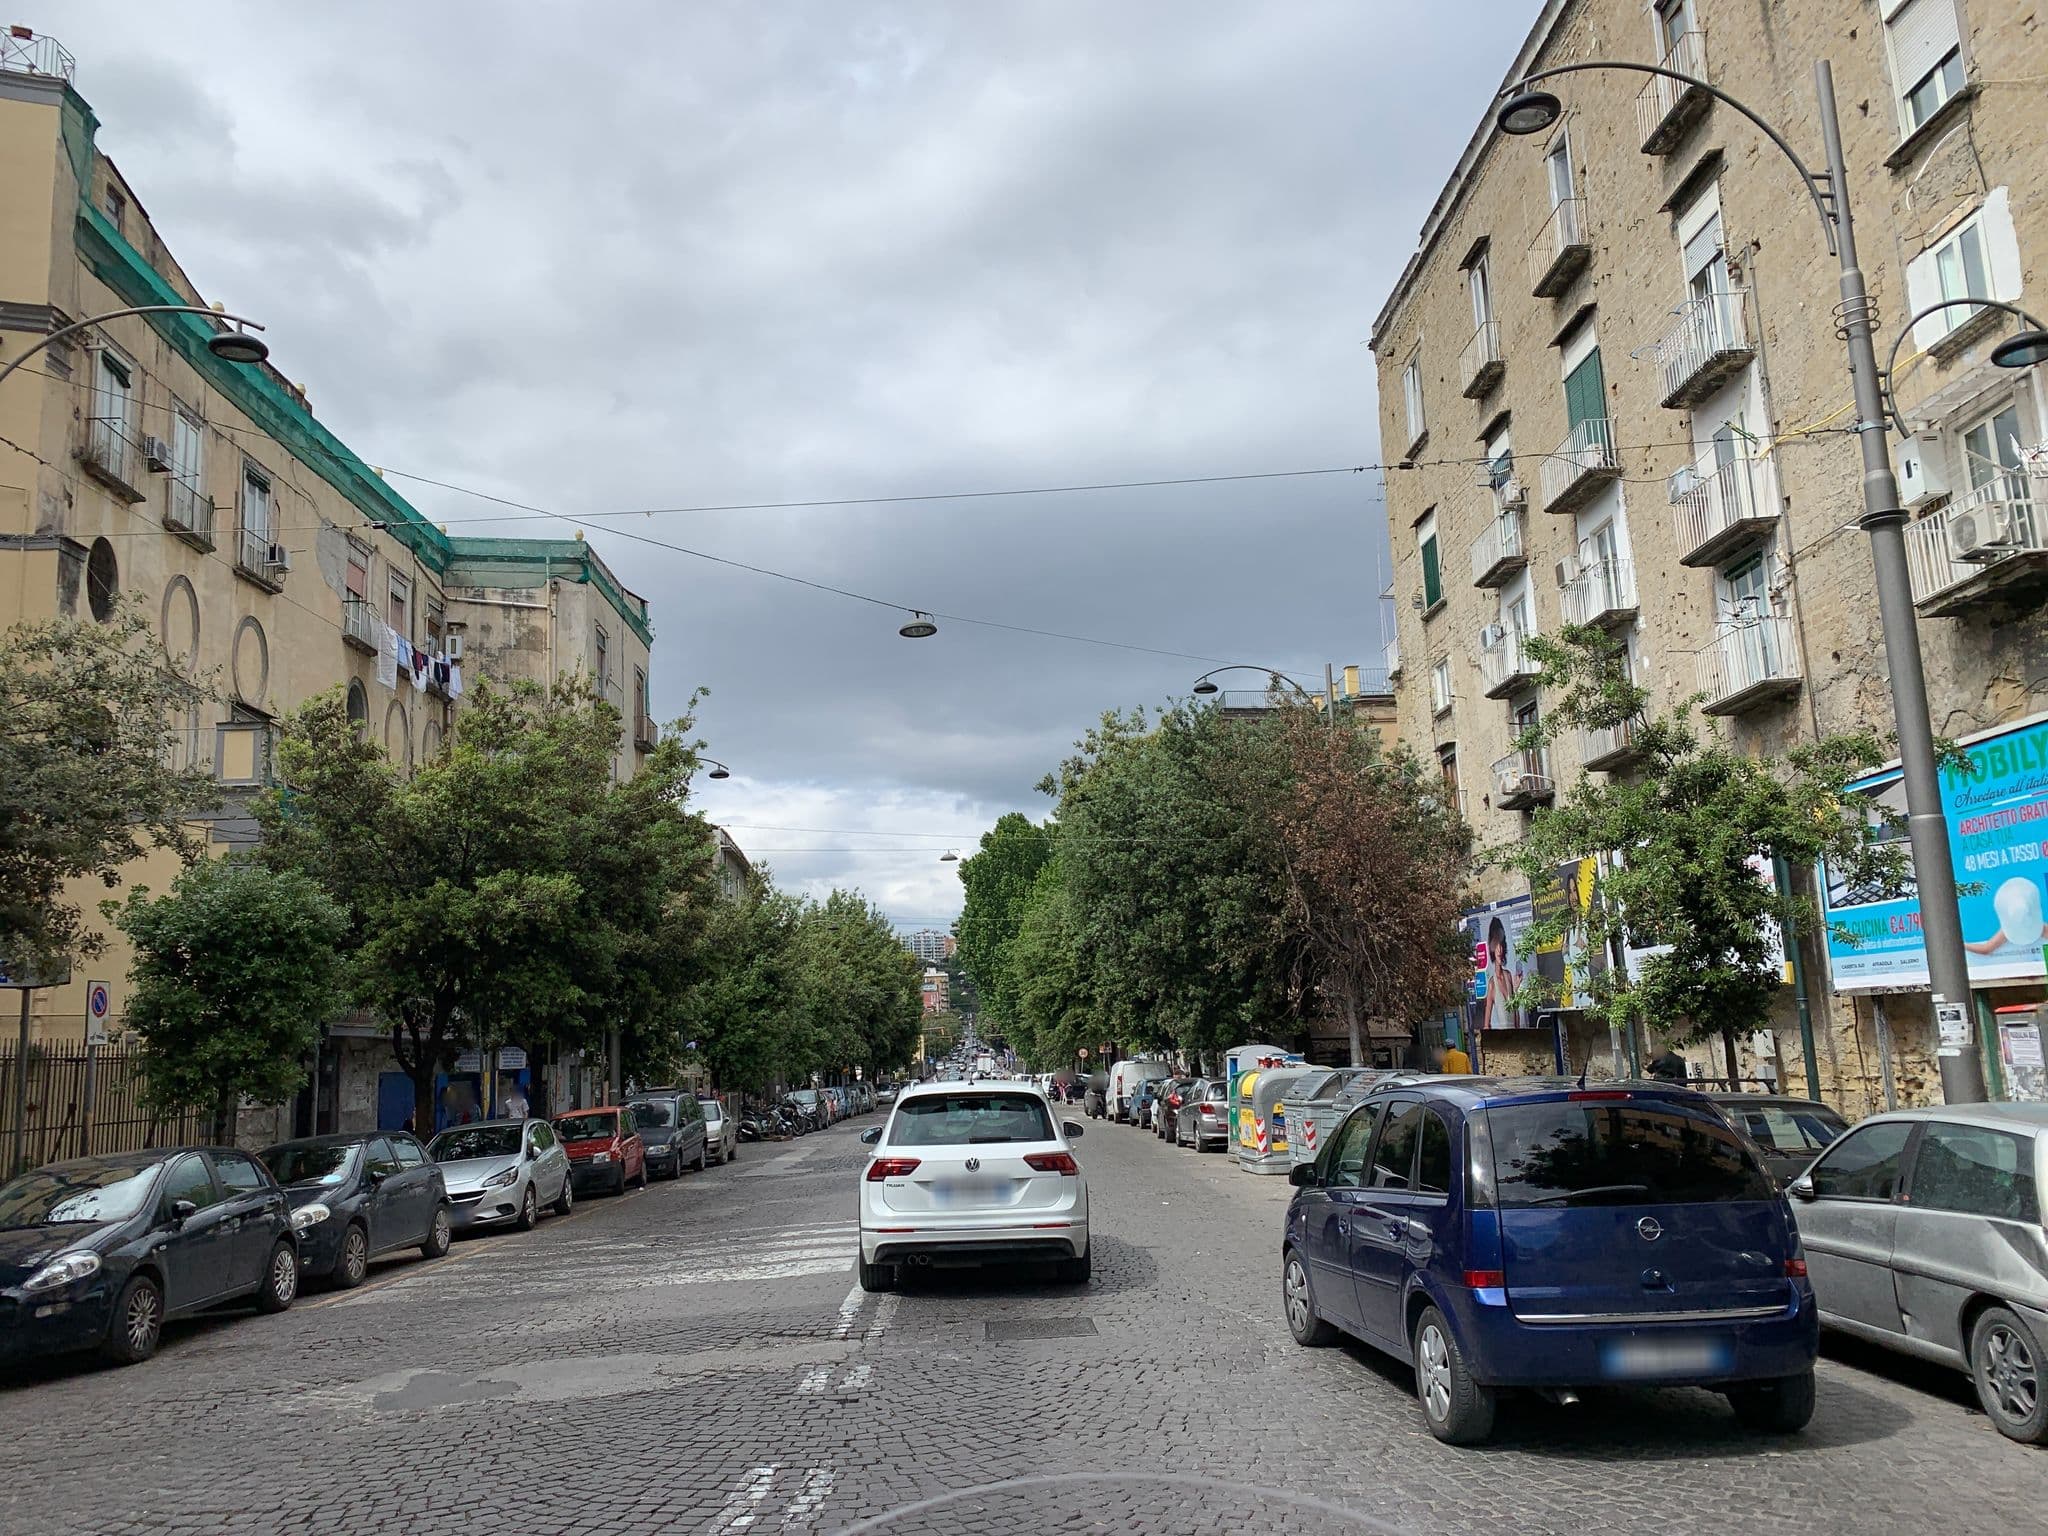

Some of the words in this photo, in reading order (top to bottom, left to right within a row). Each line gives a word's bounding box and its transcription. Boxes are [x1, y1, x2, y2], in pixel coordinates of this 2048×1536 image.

[1954, 786, 2006, 808] Arredare
[1960, 808, 2017, 836] ARCHITETTO
[1964, 854, 1977, 872] 48
[1977, 849, 2000, 870] MESI
[2001, 848, 2010, 865] A
[2008, 842, 2040, 864] TASSO
[1851, 917, 1889, 938] CUCINA
